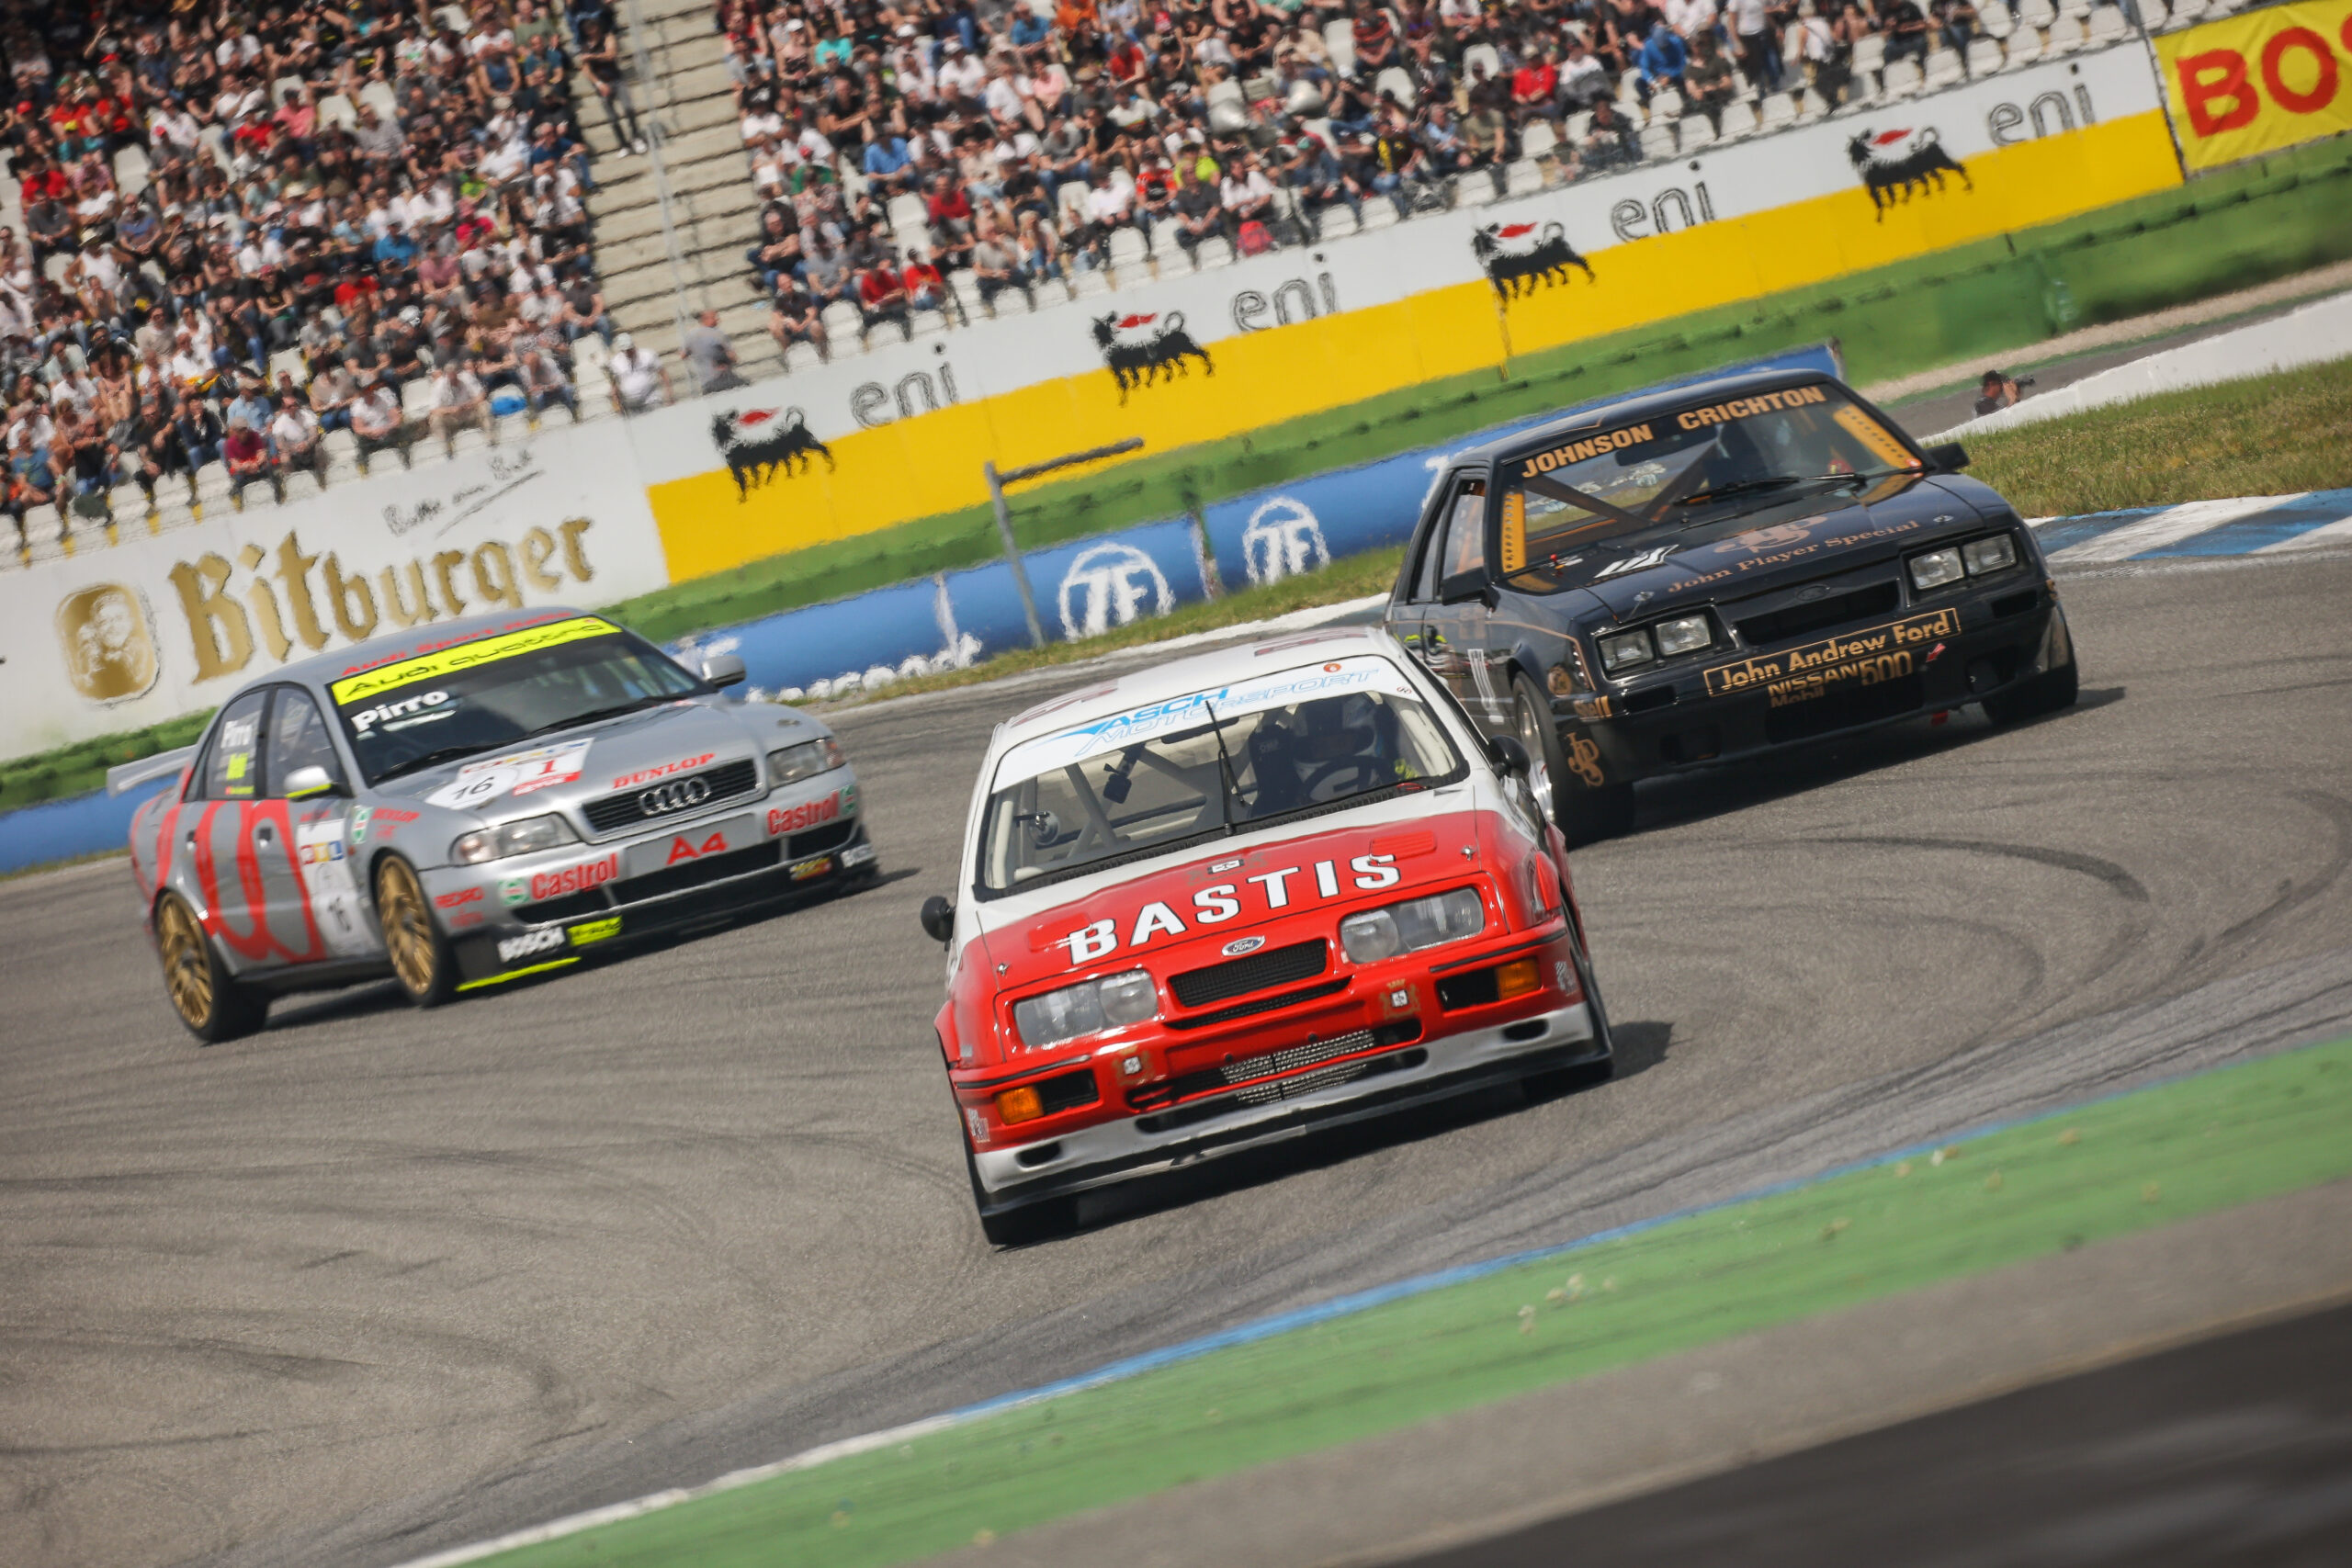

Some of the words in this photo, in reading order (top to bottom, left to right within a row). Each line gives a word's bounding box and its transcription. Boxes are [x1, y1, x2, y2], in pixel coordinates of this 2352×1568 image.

[1987, 62, 2096, 146] eni
[2175, 11, 2352, 140] BO
[1610, 160, 1719, 244] eni
[1230, 252, 1340, 333] eni
[850, 343, 959, 429] eni
[1521, 423, 1655, 479] JOHNSON
[1678, 386, 1828, 431] CRICHTON
[1668, 567, 1733, 593] John
[1735, 543, 1820, 572] Player
[1824, 519, 1921, 549] Special
[167, 516, 594, 685] Bitburger
[1720, 660, 1781, 691] John
[1788, 634, 1887, 672] Andrew
[1892, 611, 1952, 645] Ford
[1767, 662, 1860, 697] NISSAN
[1860, 649, 1914, 687] 500
[350, 690, 450, 734] Pirro
[1075, 668, 1380, 757] MOTORSPORT
[1099, 685, 1230, 733] ASCH
[1770, 685, 1826, 709] Mobil
[450, 775, 496, 801] 16
[612, 752, 717, 790] DUNLOP
[666, 830, 729, 866] A4
[766, 798, 840, 837] Castrol
[530, 852, 619, 901] Castrol
[1069, 853, 1402, 966] BASTIS
[1231, 937, 1257, 953] Ford
